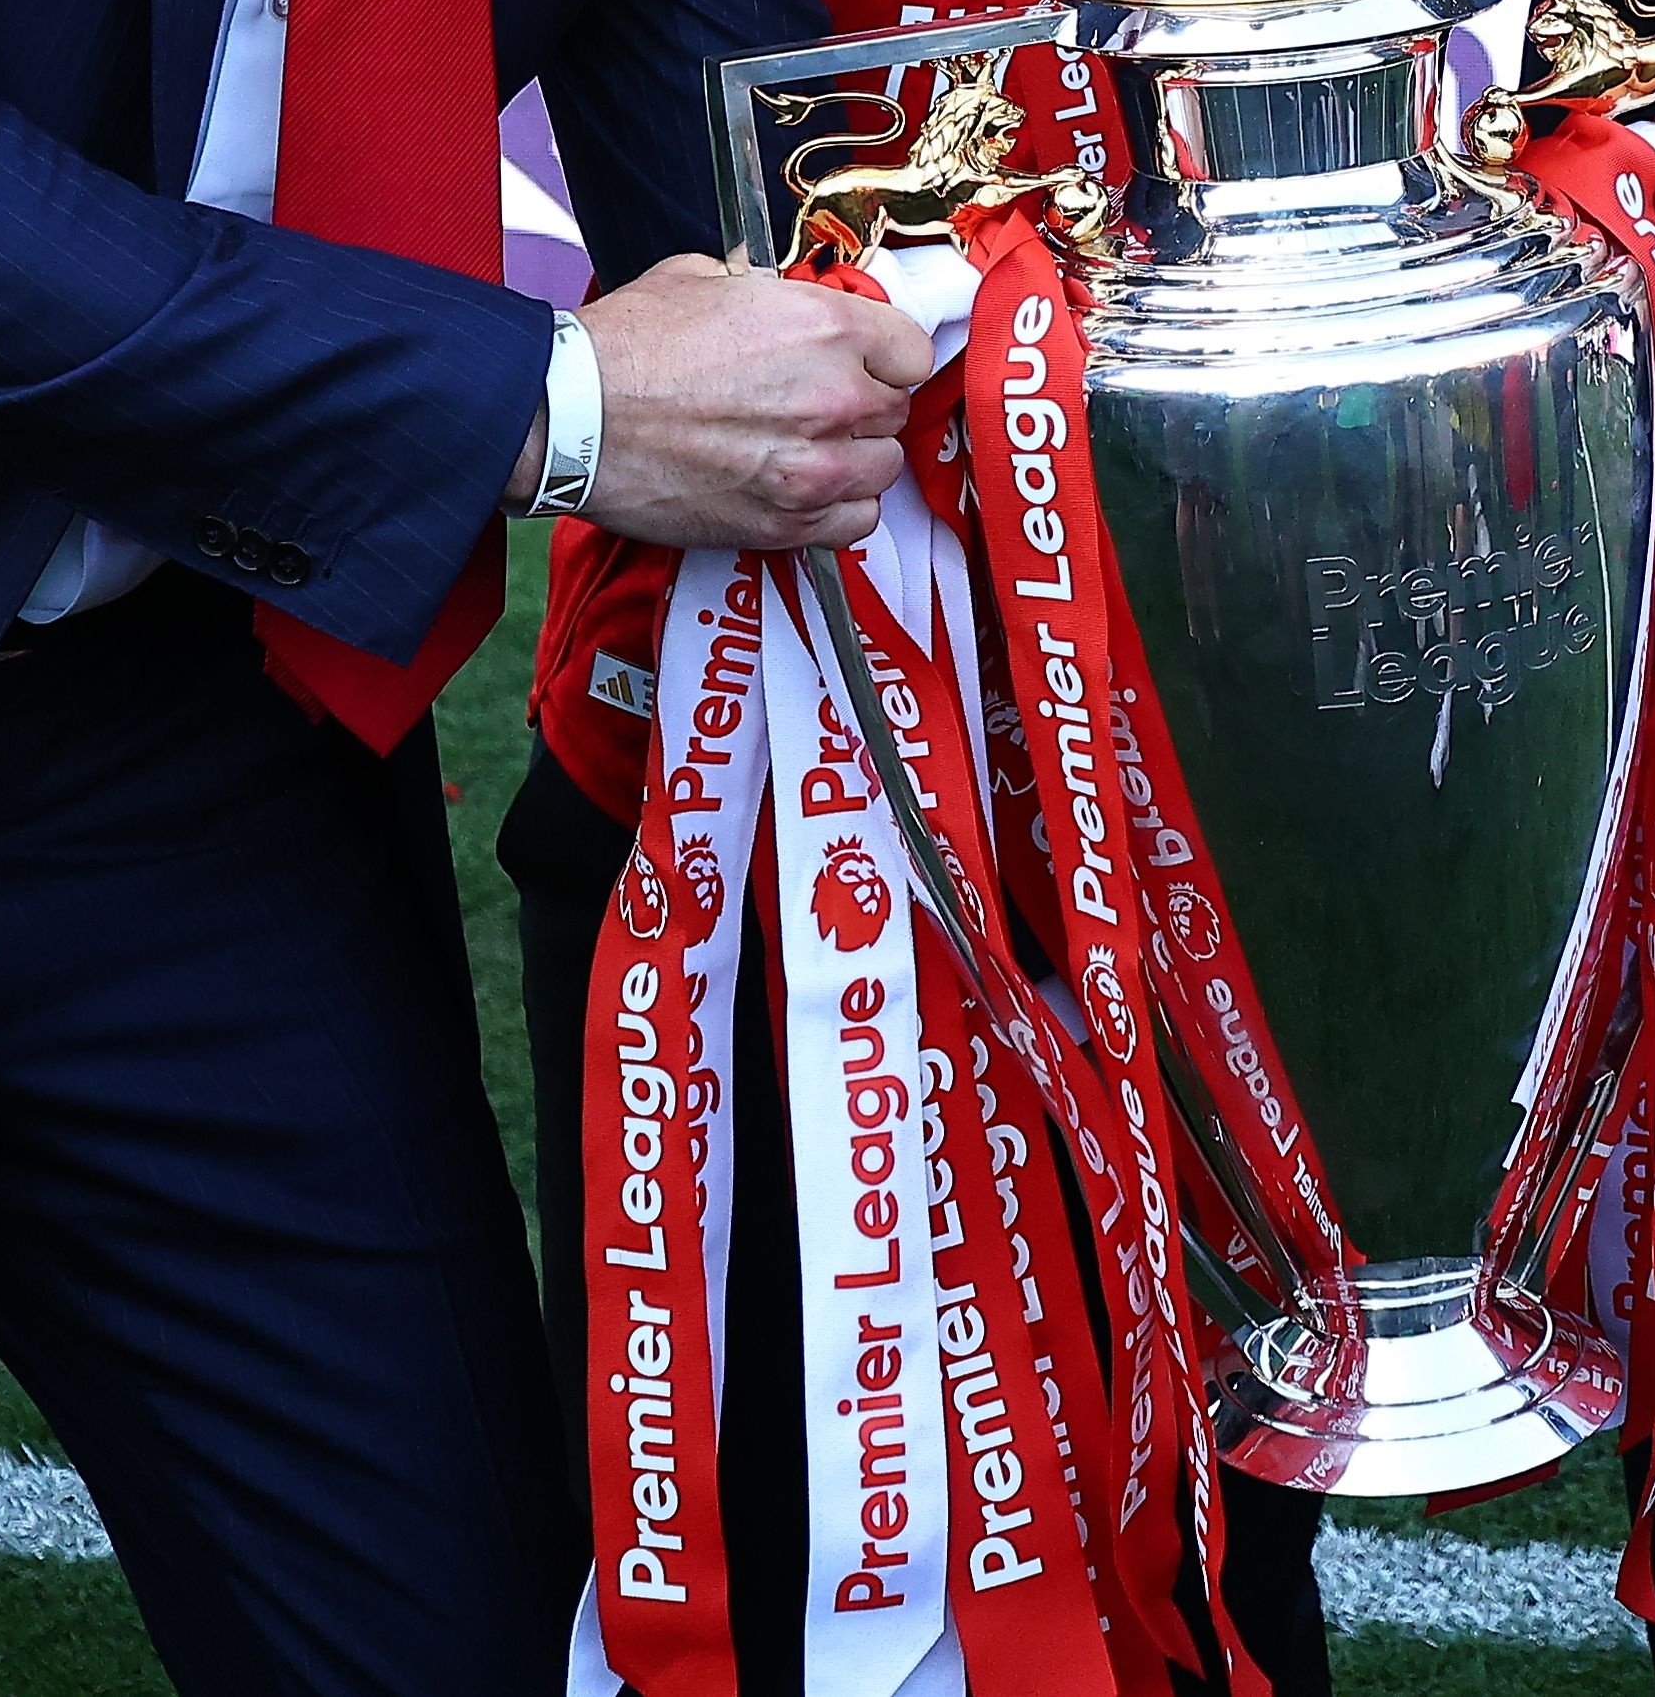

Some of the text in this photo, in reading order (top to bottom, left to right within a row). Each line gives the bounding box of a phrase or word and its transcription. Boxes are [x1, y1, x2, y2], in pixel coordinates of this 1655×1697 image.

[580, 435, 595, 466] VIP
[1304, 519, 1595, 622] Premier
[1003, 294, 1119, 927] Premier League
[1311, 596, 1599, 711] League
[605, 961, 687, 1602] Premier League
[834, 976, 909, 1613] Premier League
[1120, 1077, 1189, 1375] League
[934, 1277, 1044, 1593] Premier
[1117, 1241, 1156, 1534] Premier
